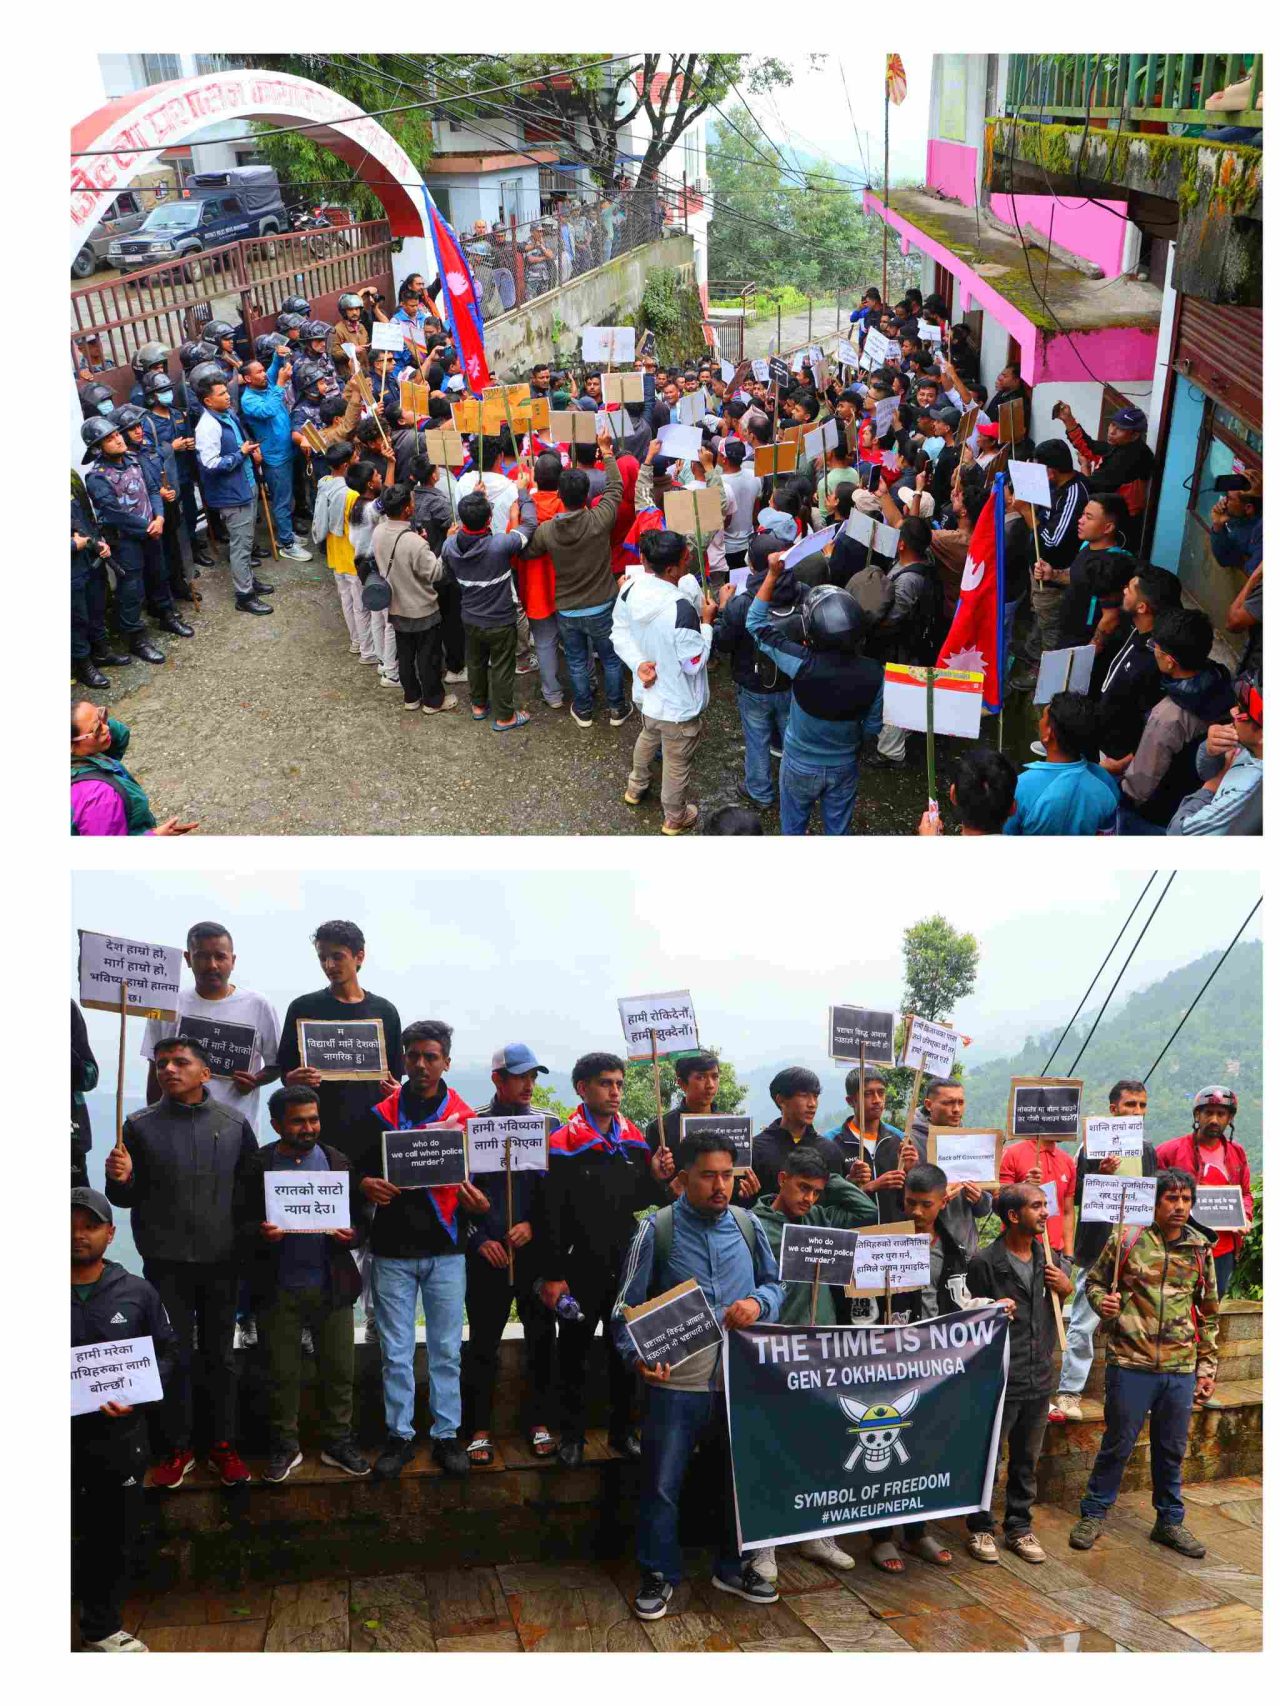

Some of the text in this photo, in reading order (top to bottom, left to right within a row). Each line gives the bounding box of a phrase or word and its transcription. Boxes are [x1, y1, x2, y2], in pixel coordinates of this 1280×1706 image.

[106, 939, 167, 961] देश हाम्रो हो,
[104, 956, 125, 969] मार्ग
[127, 961, 151, 973] हाम्रो
[125, 977, 149, 988] हाम्रो
[150, 981, 179, 993] हातमा
[626, 1010, 648, 1025] हामी
[214, 1027, 221, 1036] म
[337, 1028, 344, 1036] म
[356, 1038, 381, 1049] देशको
[323, 1051, 353, 1061] नागरिक
[472, 1119, 544, 1134] हामी भविष्यका
[429, 1139, 440, 1147] do
[474, 1137, 499, 1150] लागी
[405, 1150, 418, 1158] call
[441, 1148, 463, 1157] police
[411, 1158, 445, 1167] murder?
[274, 1182, 344, 1195] रगतको साटो
[284, 1205, 311, 1215] न्याय
[814, 1247, 832, 1255] when
[752, 1319, 996, 1365] THE TIME IS NOW
[75, 1344, 133, 1363] हामी मरेका
[125, 1356, 151, 1370] लागी
[787, 1357, 965, 1391] GEN Z OKHALDHUNGA
[794, 1472, 951, 1510] SYMBOL OF FREEDOM
[821, 1496, 924, 1524] #WAKEUPNEPAL
